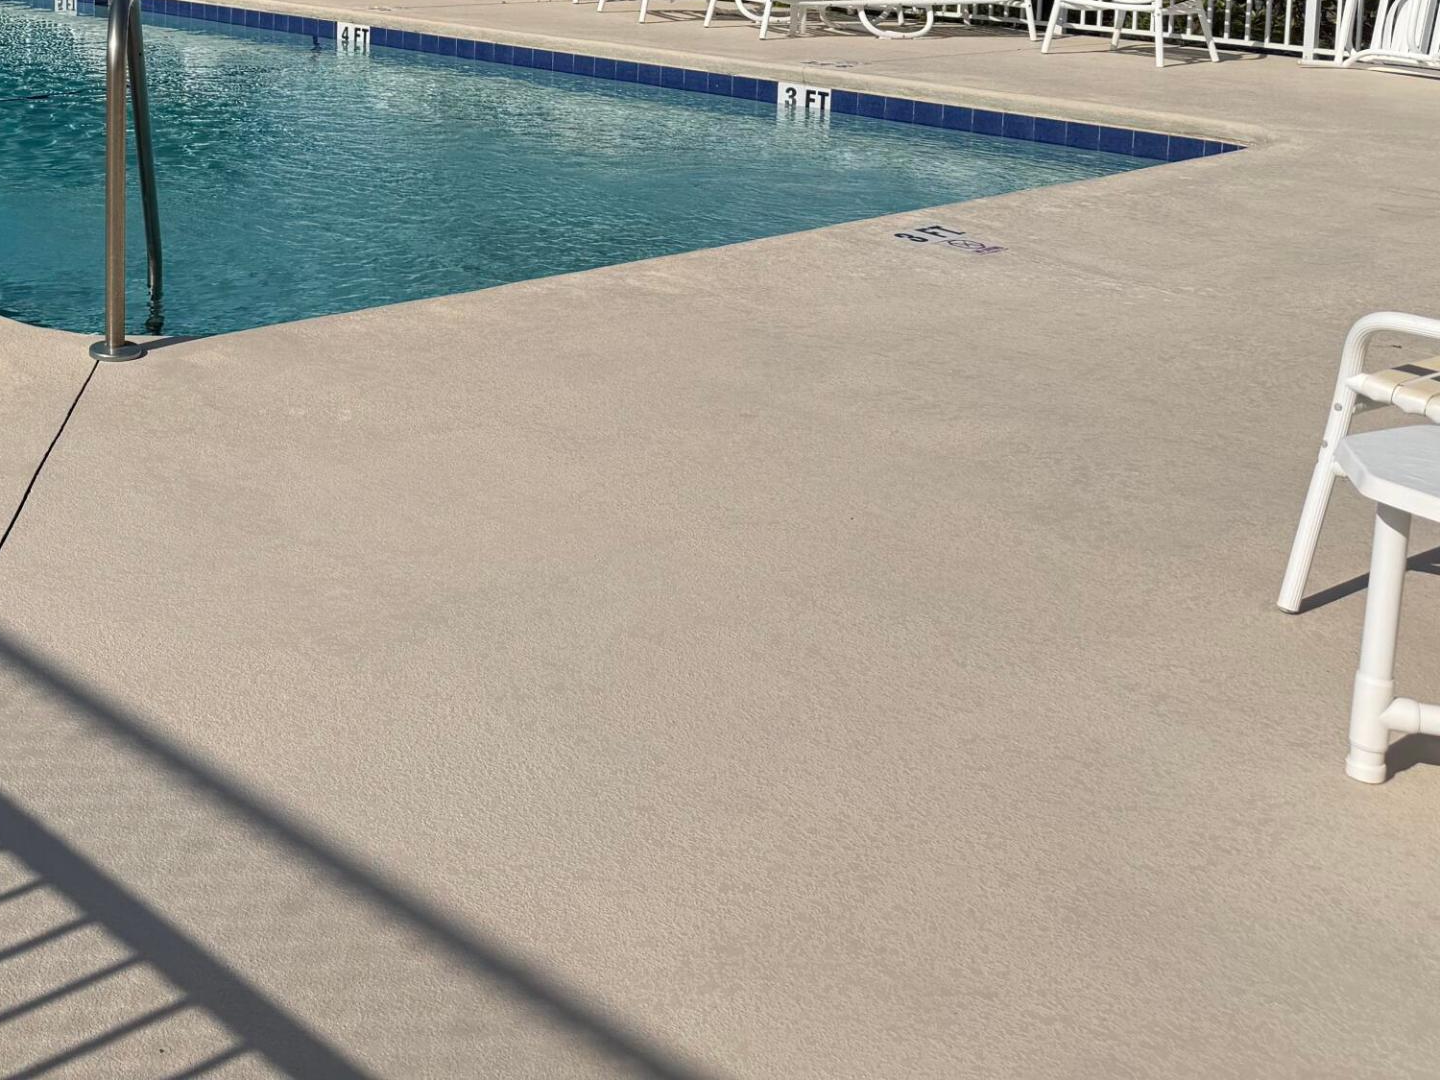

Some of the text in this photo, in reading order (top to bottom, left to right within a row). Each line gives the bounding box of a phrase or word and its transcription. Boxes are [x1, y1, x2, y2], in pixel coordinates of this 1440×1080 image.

[341, 26, 369, 45] 4 FT
[784, 87, 829, 110] 3 FT
[894, 225, 966, 243] 3 FT
